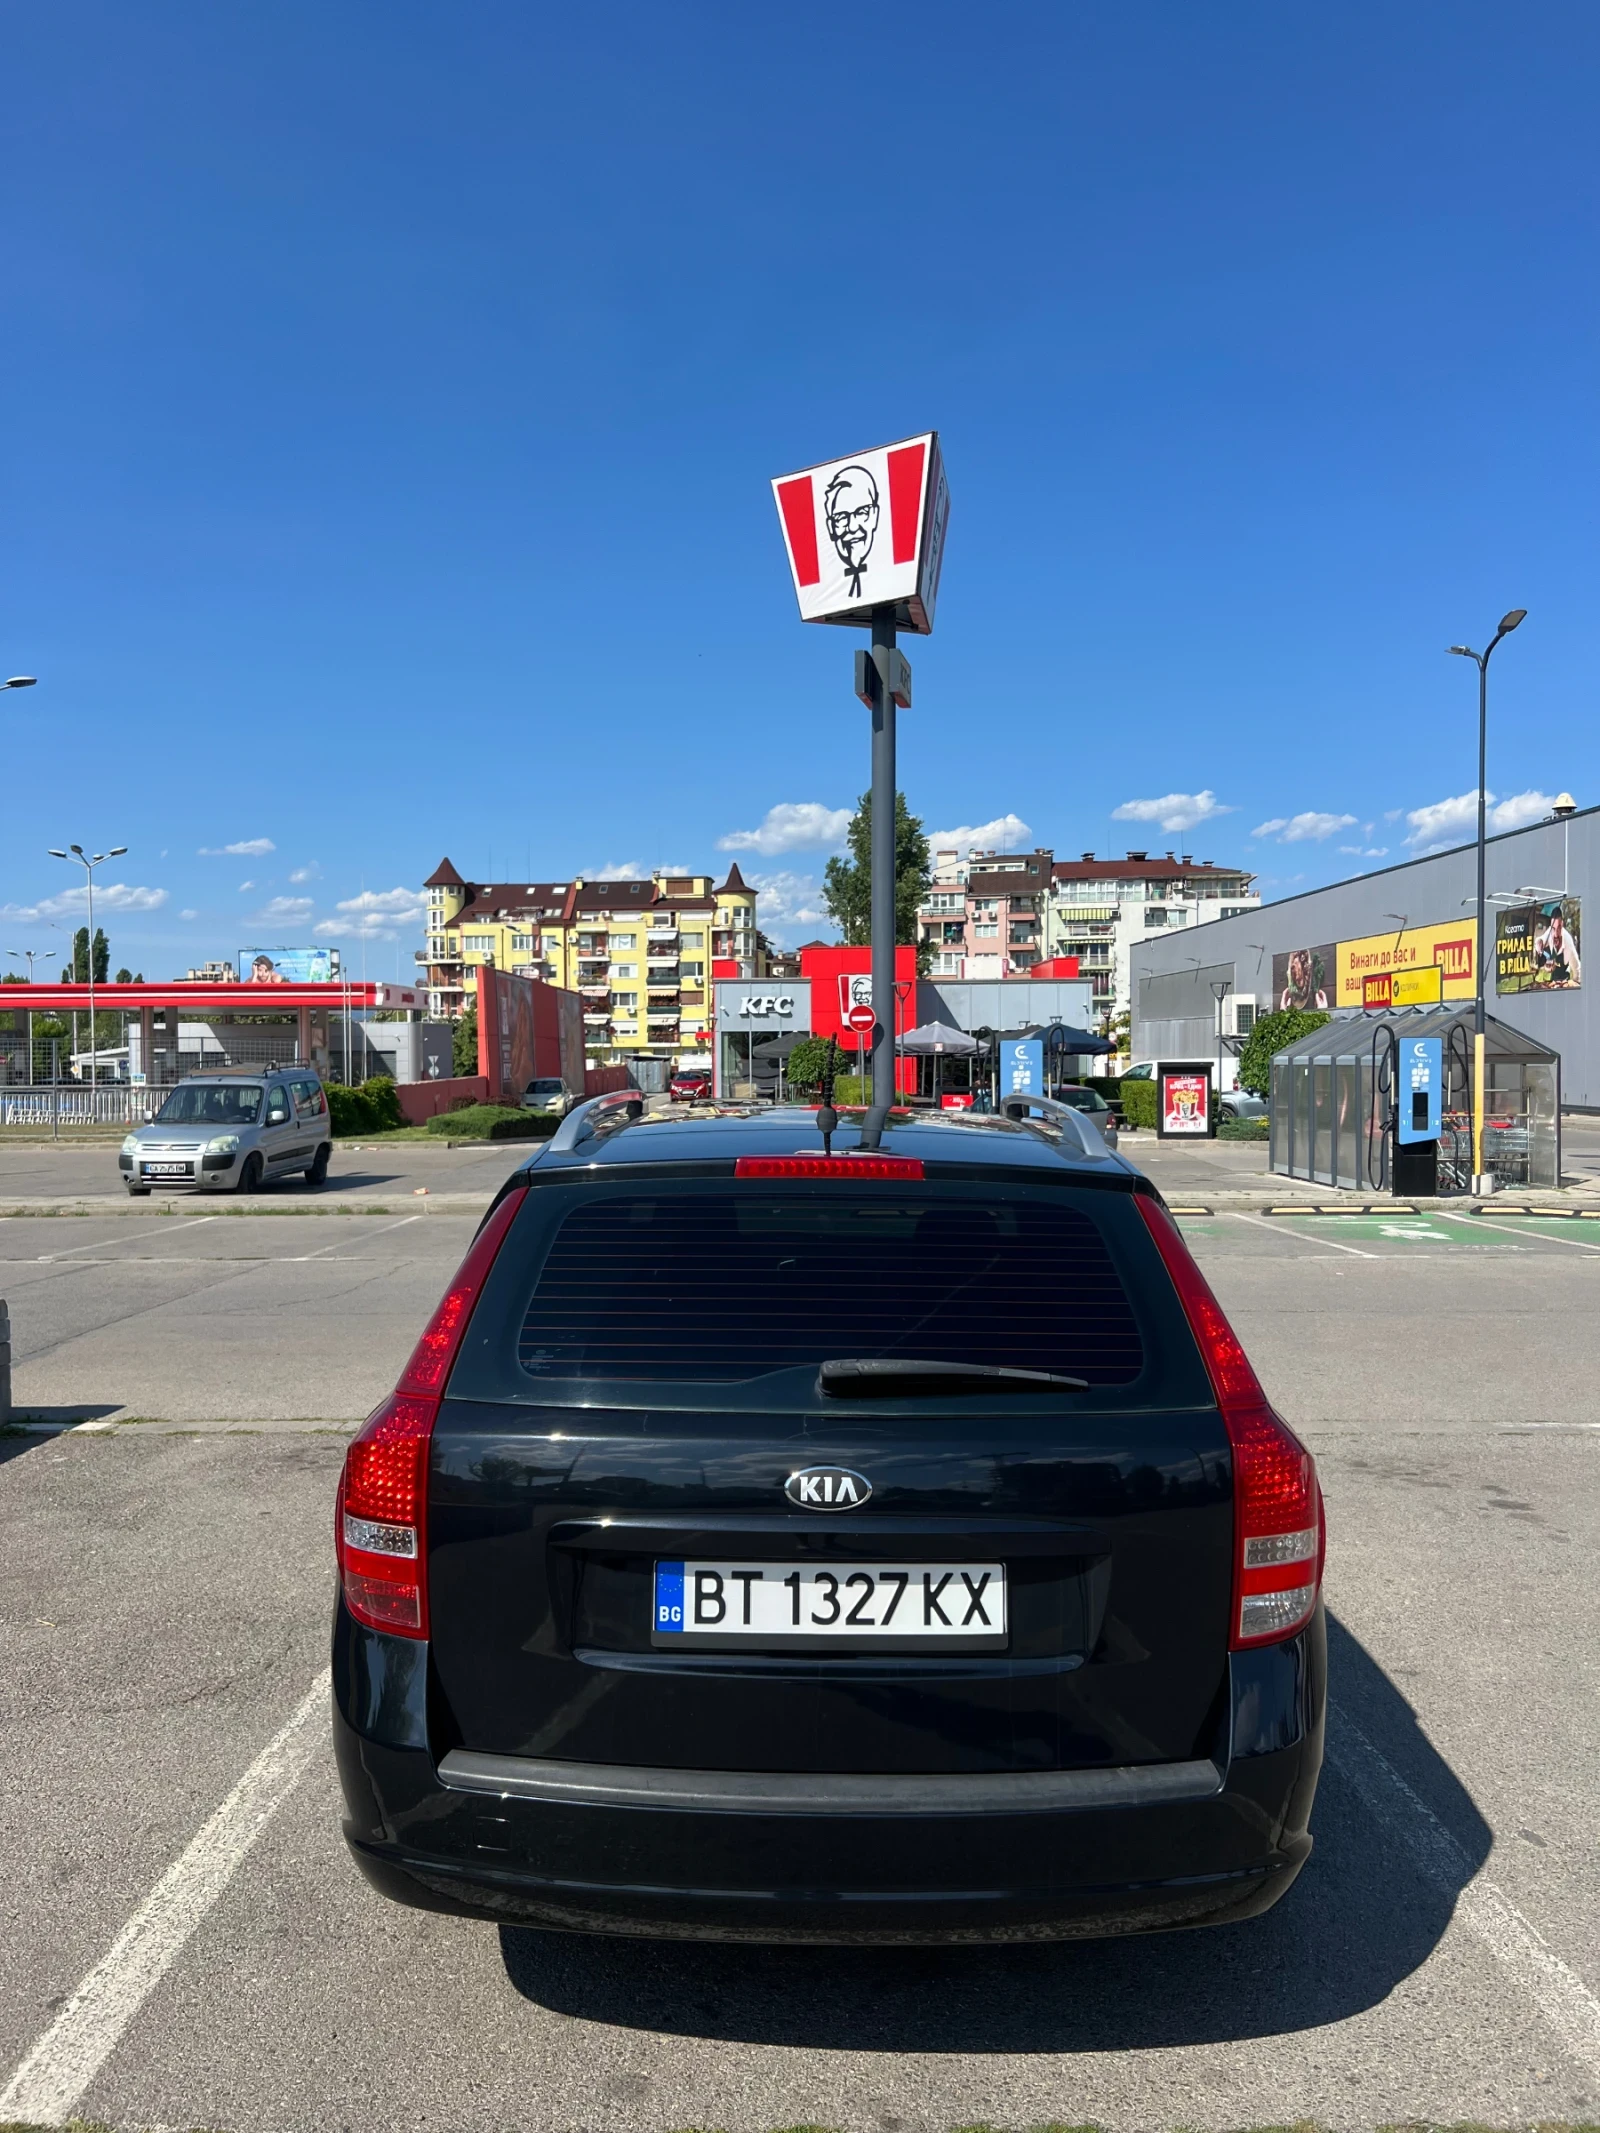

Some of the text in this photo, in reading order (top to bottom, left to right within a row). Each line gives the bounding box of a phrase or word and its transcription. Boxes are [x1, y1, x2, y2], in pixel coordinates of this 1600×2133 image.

[1497, 935, 1533, 955] ГРИЛА Е
[1350, 947, 1416, 970] Винаги до вас и
[1435, 946, 1470, 975] BILLA
[1508, 956, 1530, 975] BILLA
[1365, 980, 1390, 1003] BILLA
[738, 996, 793, 1015] KFC
[799, 1476, 858, 1502] KIA
[659, 1570, 992, 1626] BG BT 1327 KX
